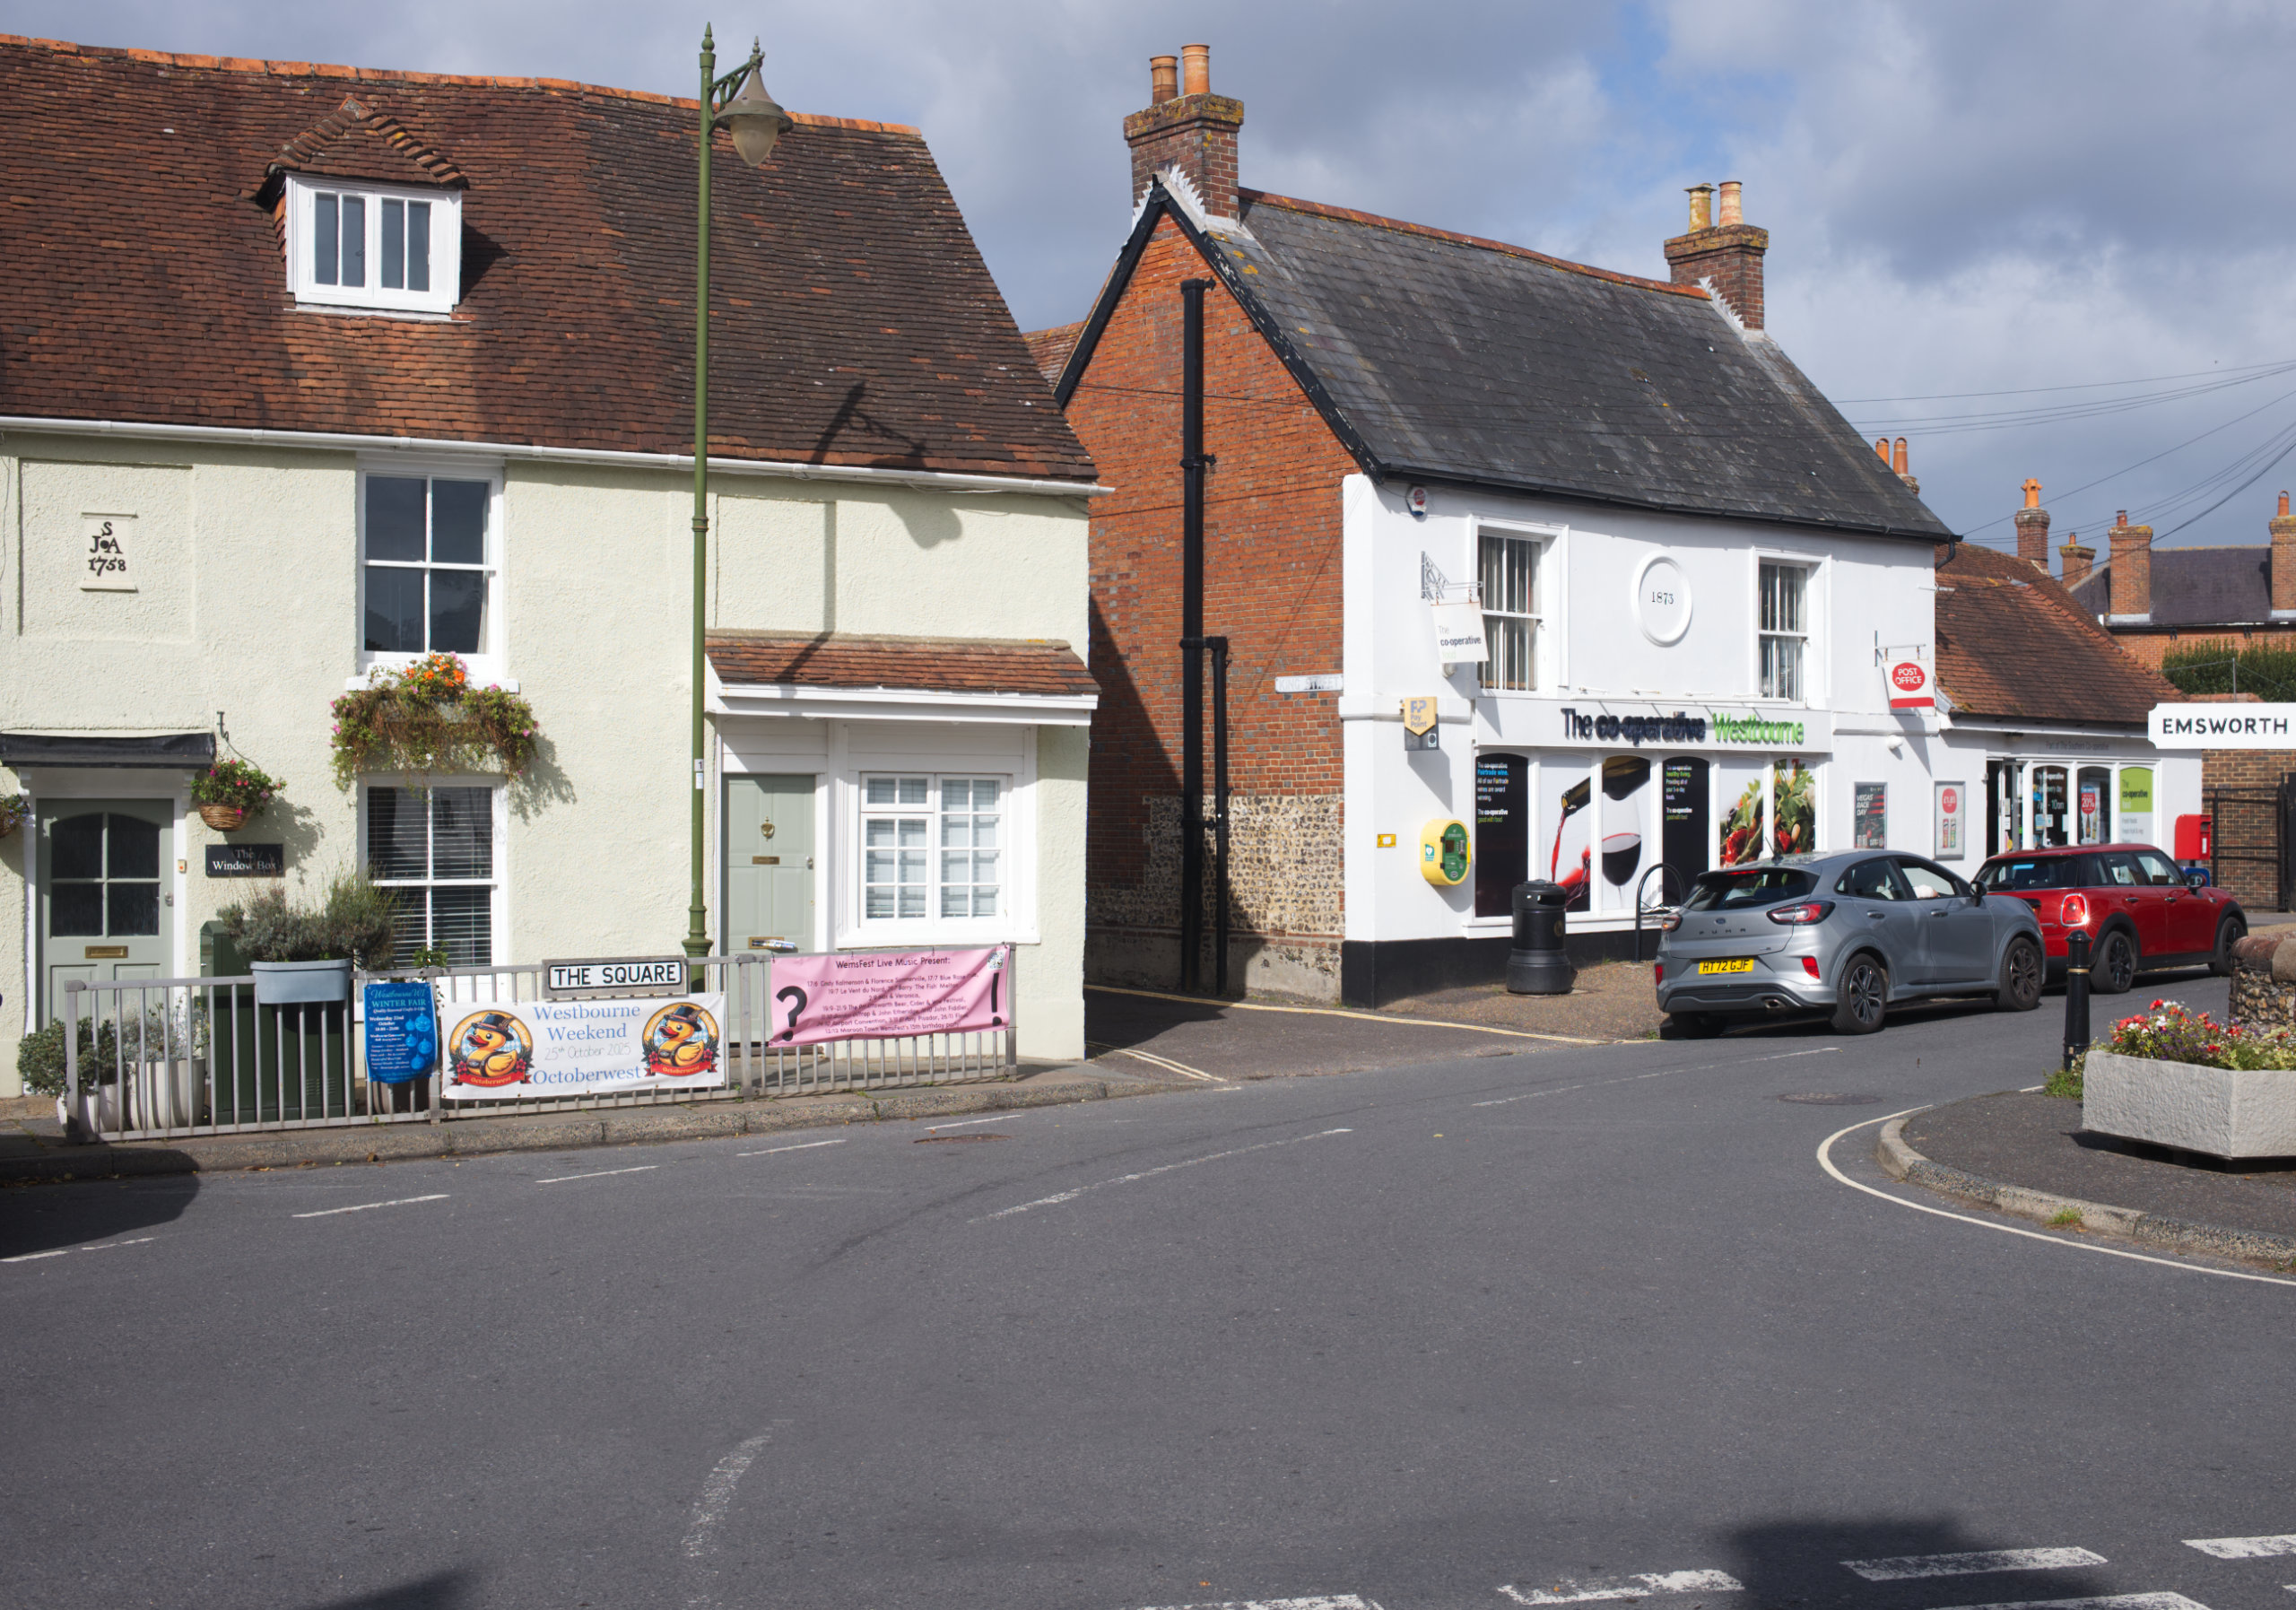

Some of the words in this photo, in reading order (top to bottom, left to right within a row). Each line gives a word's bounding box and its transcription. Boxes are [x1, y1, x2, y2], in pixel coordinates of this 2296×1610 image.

[88, 555, 126, 577] 1758
[1651, 591, 1674, 605] 1873
[1438, 625, 1449, 634] The
[1440, 636, 1482, 648] co-operative
[1898, 667, 1918, 676] POST
[1895, 675, 1922, 685] OFFICE
[1561, 708, 1593, 739] The
[1596, 711, 1706, 747] co-operative
[1712, 712, 1805, 745] Westbourne
[2162, 718, 2288, 735] EMSWORTH
[2122, 789, 2148, 799] co-operative
[1856, 801, 1870, 809] RACE
[2082, 797, 2095, 808] 20%
[1483, 808, 1509, 816] co-operative
[1672, 806, 1692, 814] co-operative
[1856, 808, 1868, 816] DAY
[235, 849, 255, 858] The
[213, 860, 253, 871] Window
[257, 860, 276, 869] Box
[836, 960, 874, 969] WemsFest
[877, 959, 892, 967] Live
[895, 958, 918, 966] Music
[920, 957, 951, 965] Present:
[1702, 961, 1728, 972] HT72
[1730, 959, 1750, 970] GJF
[554, 968, 591, 987] THE
[602, 964, 676, 984] SQUARE
[370, 988, 412, 998] Westbourne
[371, 999, 406, 1007] WINTER
[532, 1004, 640, 1021] Westbourne
[546, 1023, 627, 1041] Weekend
[544, 1047, 565, 1061] 25th
[567, 1045, 604, 1059] October
[607, 1042, 631, 1056] 2025
[470, 1076, 512, 1085] Octoberwest
[533, 1066, 641, 1084] Octoberwest
